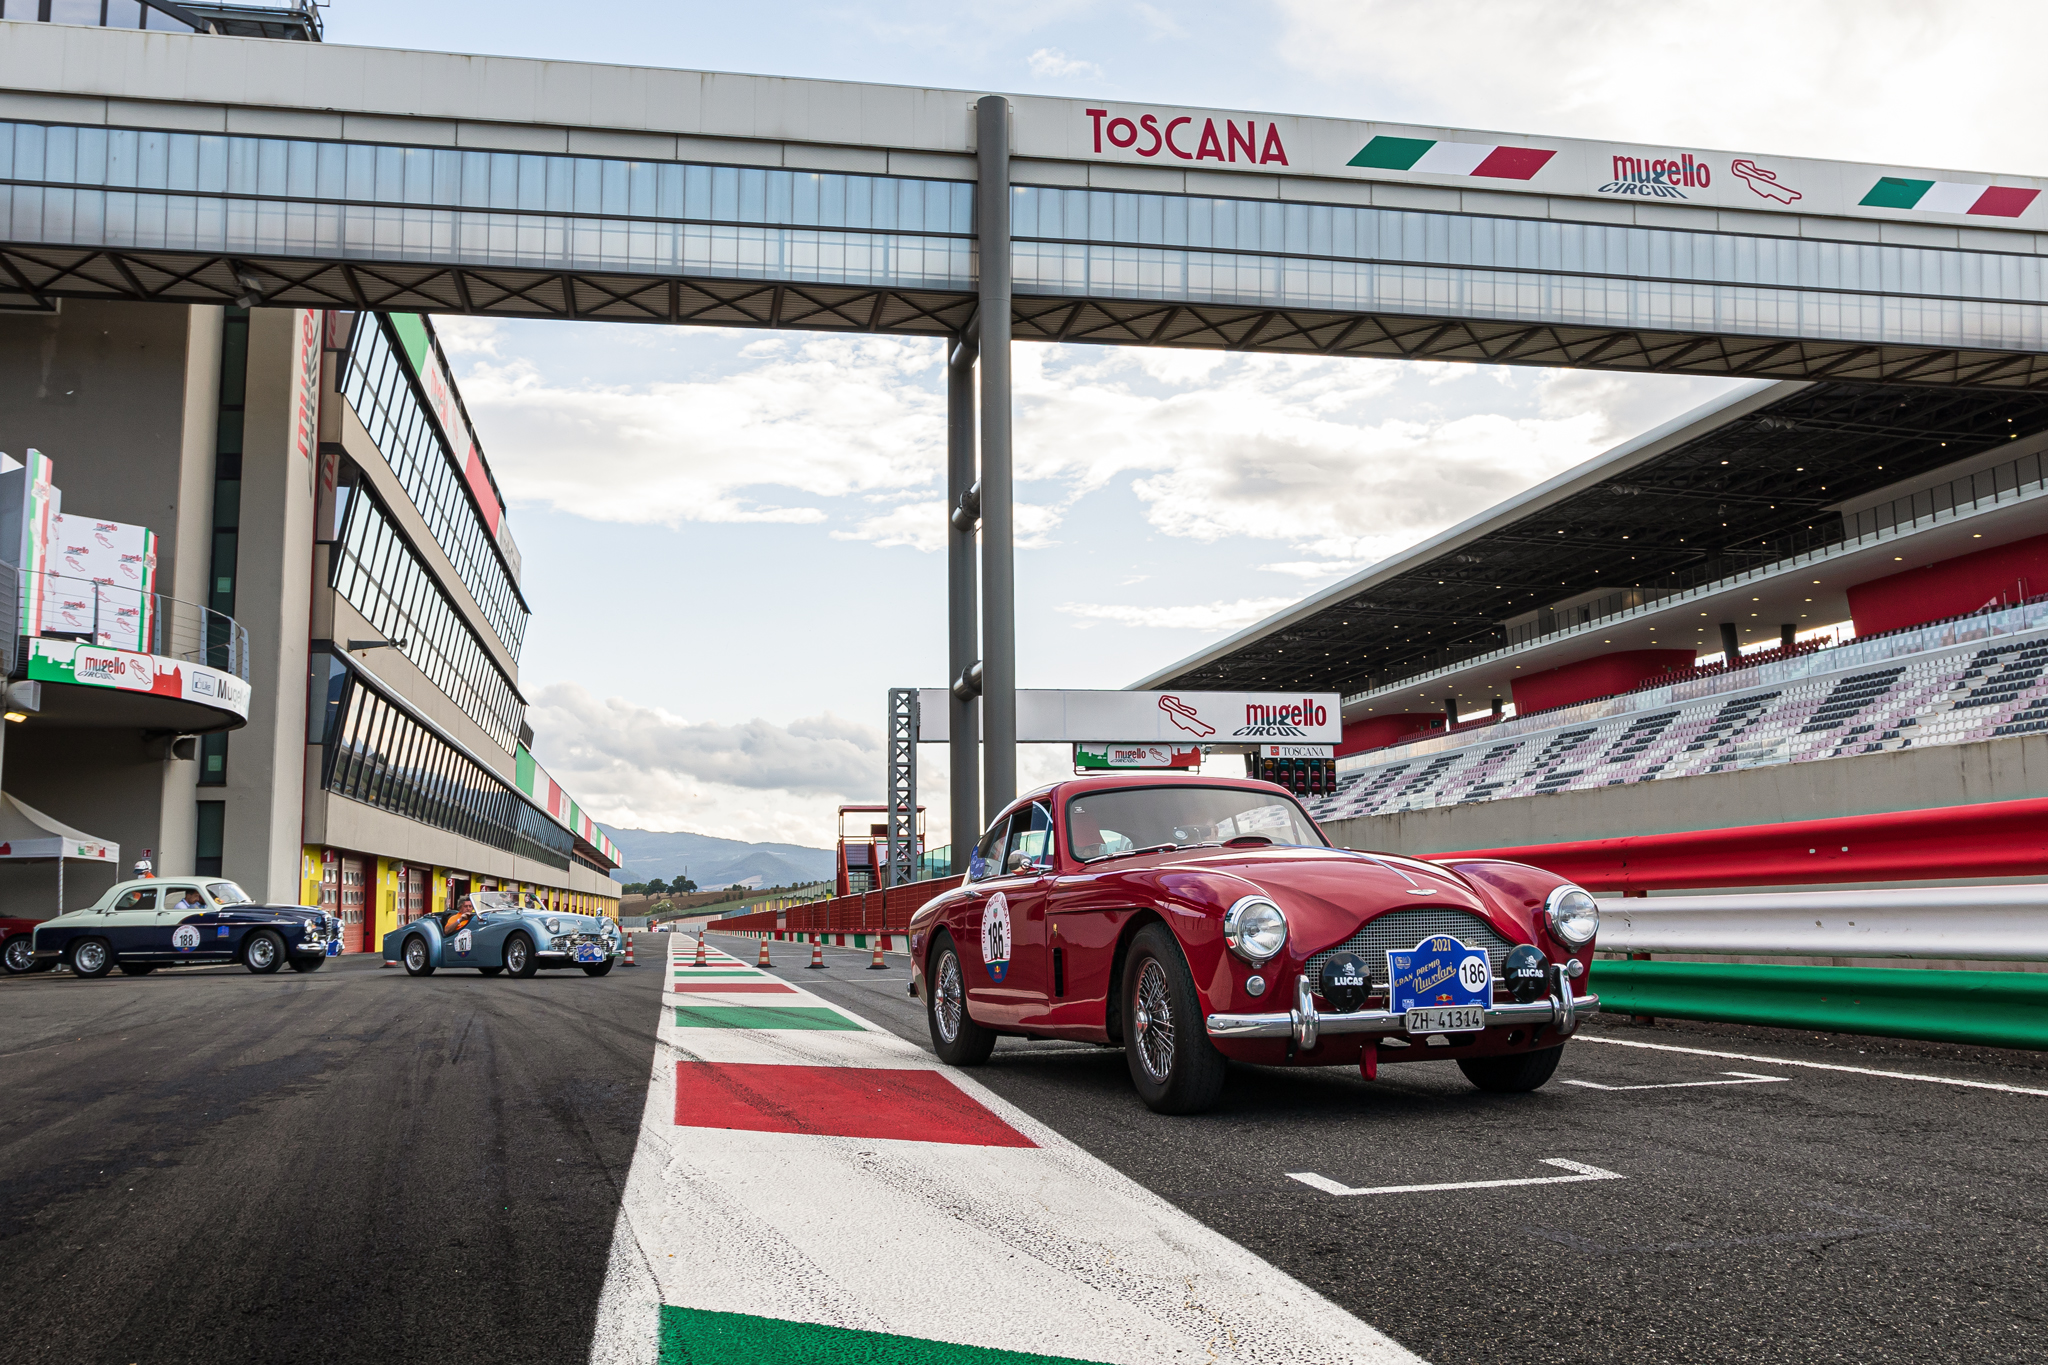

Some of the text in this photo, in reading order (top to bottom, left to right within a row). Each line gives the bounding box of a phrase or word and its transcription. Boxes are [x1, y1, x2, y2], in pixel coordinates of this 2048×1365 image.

[1612, 153, 1710, 188] mugello
[1598, 181, 1689, 199] CIRCUIT
[85, 656, 126, 675] mugello
[77, 670, 115, 680] CIRCUIT
[1246, 698, 1327, 727] mugello
[1232, 726, 1308, 737] CIRCUIT
[1115, 748, 1146, 759] mugello
[1282, 746, 1325, 757] TOSCANA
[324, 850, 331, 862] 1
[398, 867, 405, 877] 2
[447, 878, 453, 887] 3
[179, 934, 193, 946] 188
[988, 920, 1004, 960] 186
[1431, 938, 1452, 951] 2021
[1394, 973, 1413, 987] GRAN
[1416, 958, 1440, 976] PREMIO
[1412, 962, 1456, 993] Nuvolari
[1461, 963, 1486, 984] 186
[1517, 968, 1544, 978] LUCAS
[1334, 977, 1363, 986] LUCAS
